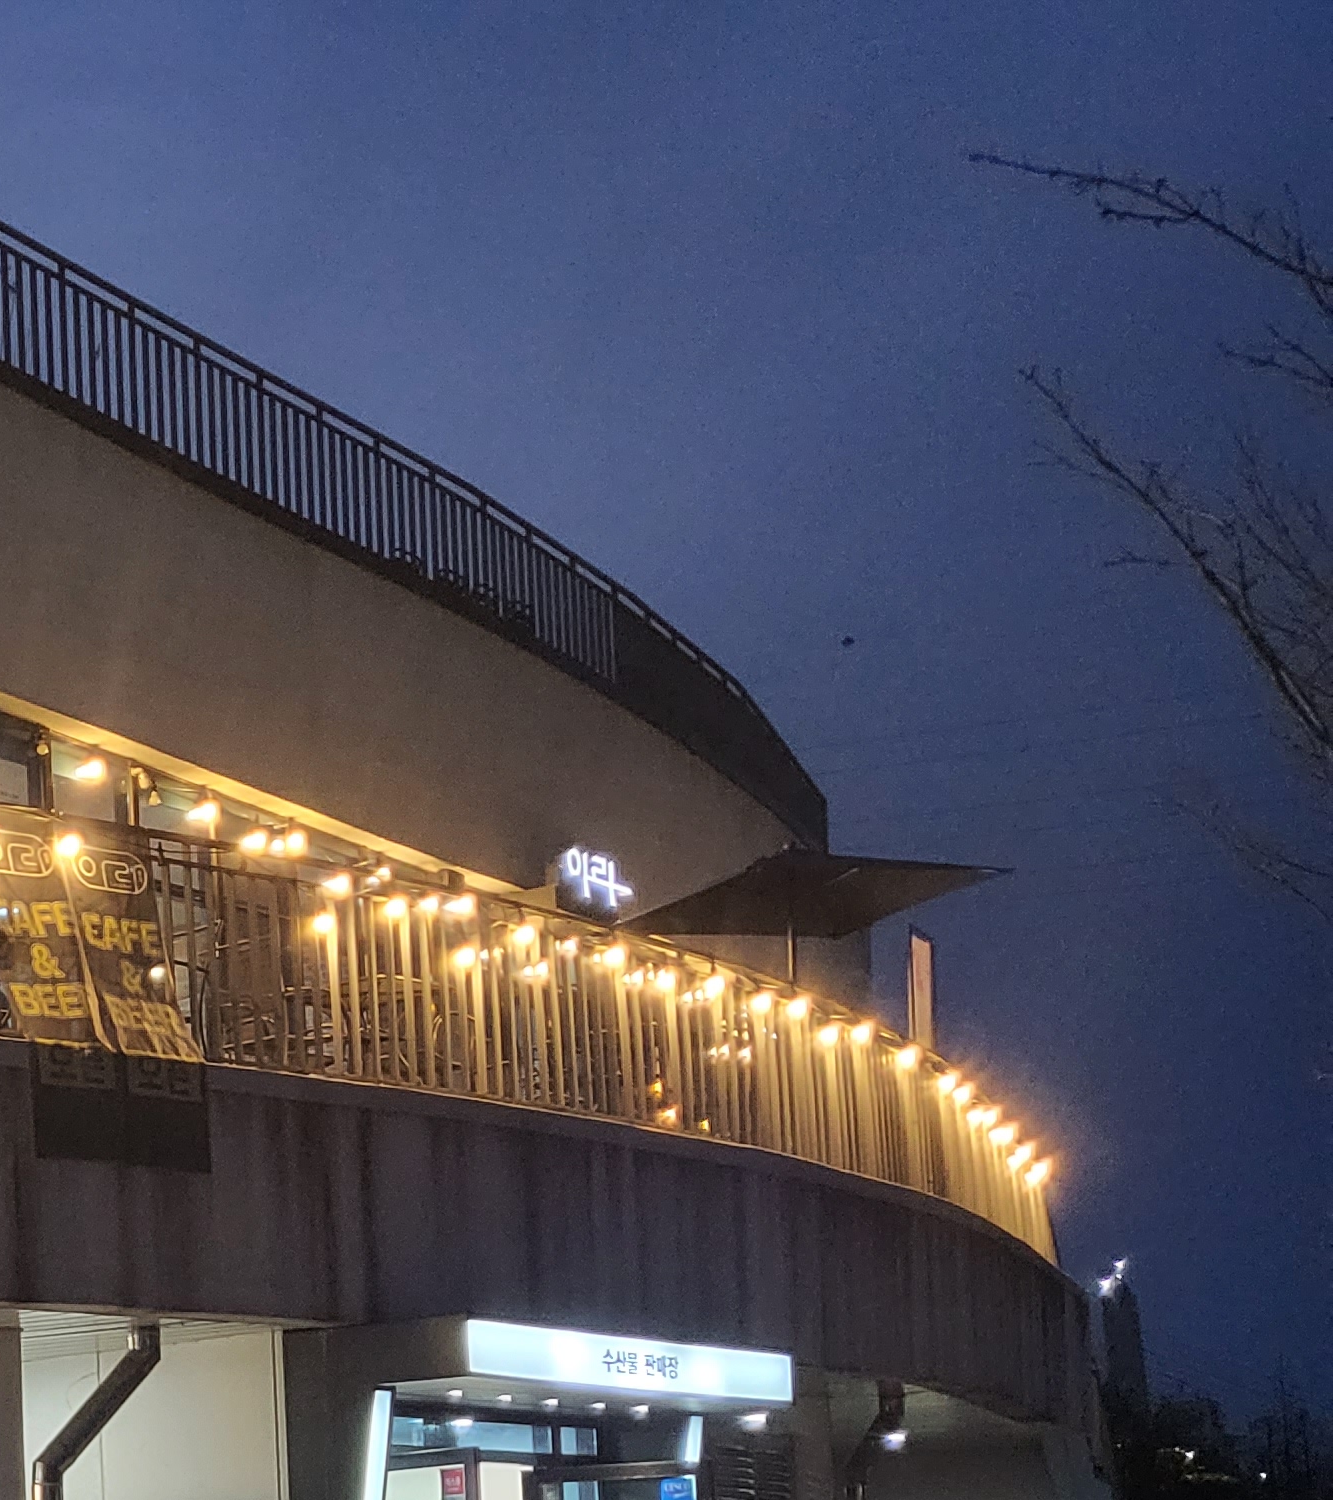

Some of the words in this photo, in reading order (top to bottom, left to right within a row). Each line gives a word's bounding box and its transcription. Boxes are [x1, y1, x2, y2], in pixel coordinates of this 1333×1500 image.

[31, 943, 66, 978] &
[9, 982, 89, 1018] BEE
[601, 1348, 639, 1374] 수산물
[644, 1353, 680, 1379] 판매장
